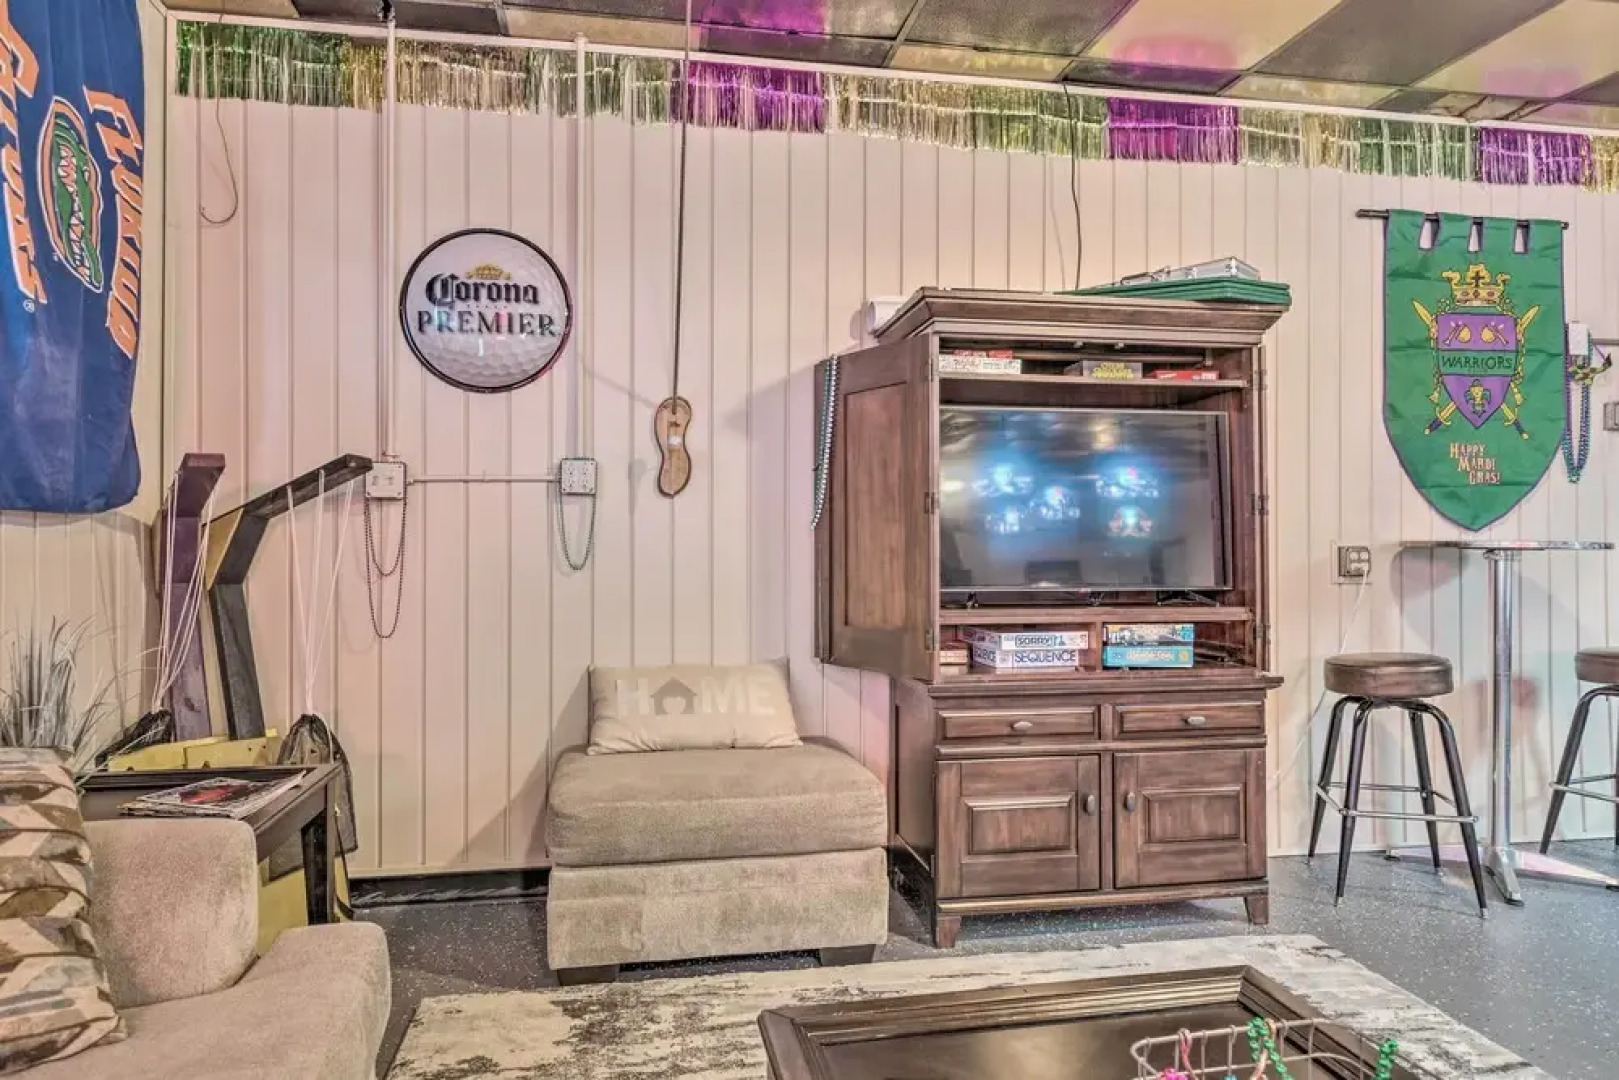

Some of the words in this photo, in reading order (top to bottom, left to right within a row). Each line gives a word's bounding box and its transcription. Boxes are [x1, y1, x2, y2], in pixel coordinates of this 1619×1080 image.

[425, 272, 540, 308] Corona
[418, 310, 557, 337] PREMIER
[1442, 355, 1514, 370] WARRIORS
[1450, 442, 1486, 459] HAPPY
[1457, 456, 1497, 472] MARDI
[1014, 651, 1076, 663] SEQUENCE
